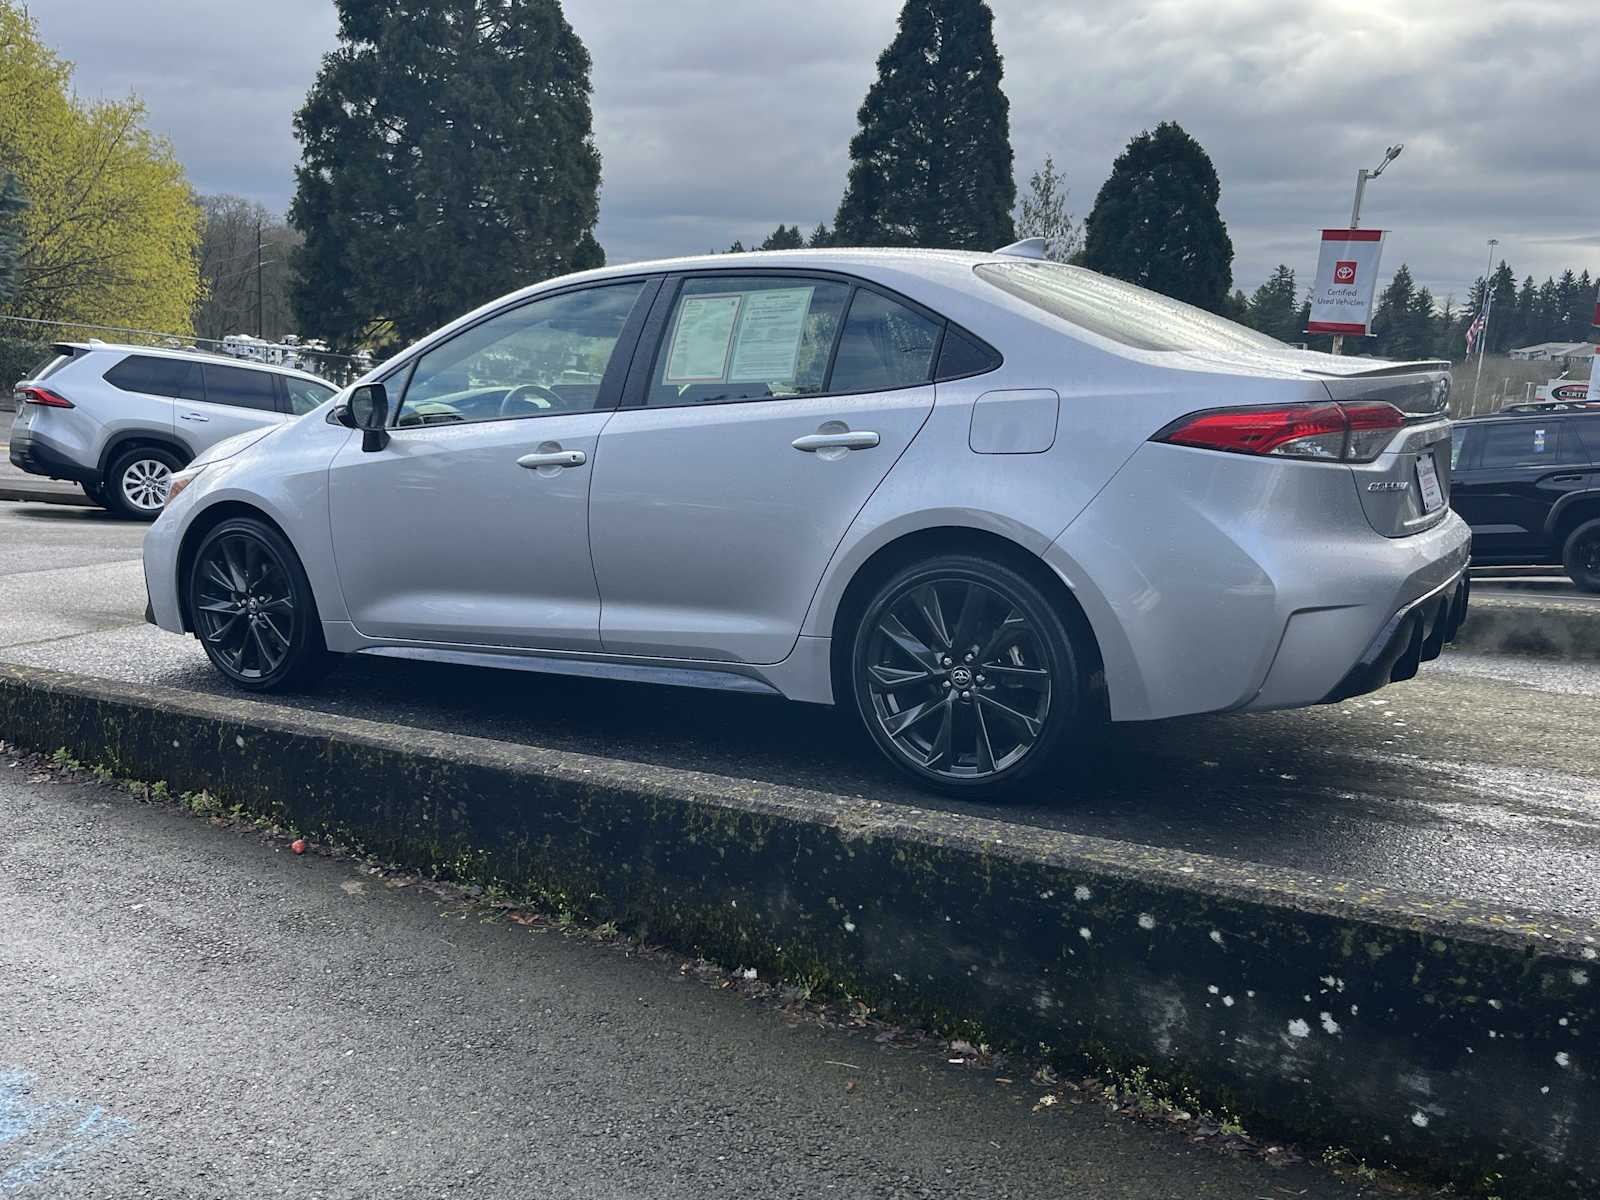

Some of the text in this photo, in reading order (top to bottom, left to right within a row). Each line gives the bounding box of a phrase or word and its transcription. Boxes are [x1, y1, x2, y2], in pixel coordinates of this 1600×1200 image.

[1327, 288, 1357, 296] Certified
[1317, 297, 1365, 306] Used Vehicles
